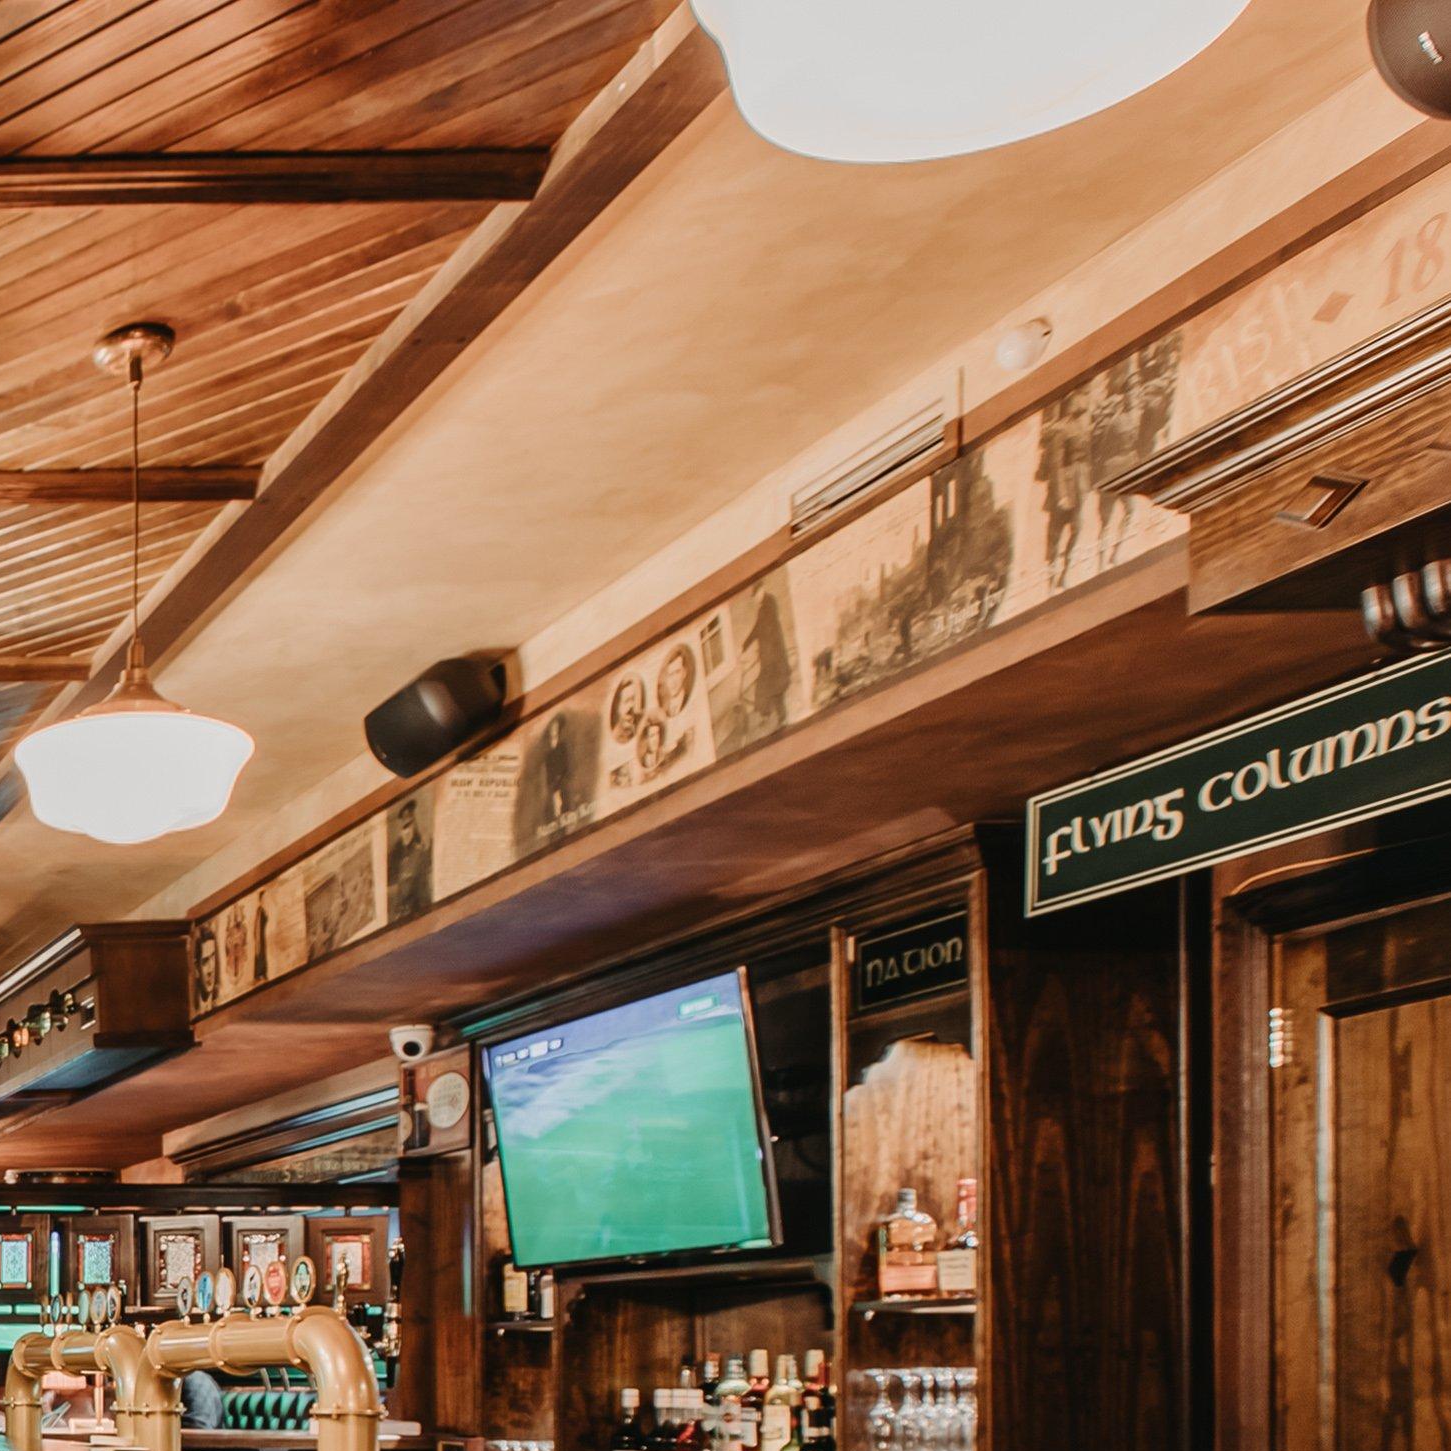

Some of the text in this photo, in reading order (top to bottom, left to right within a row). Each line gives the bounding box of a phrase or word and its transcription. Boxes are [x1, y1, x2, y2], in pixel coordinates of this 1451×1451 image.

[1042, 695, 1451, 876] FLYING COLUMNS
[865, 936, 964, 988] NATION
